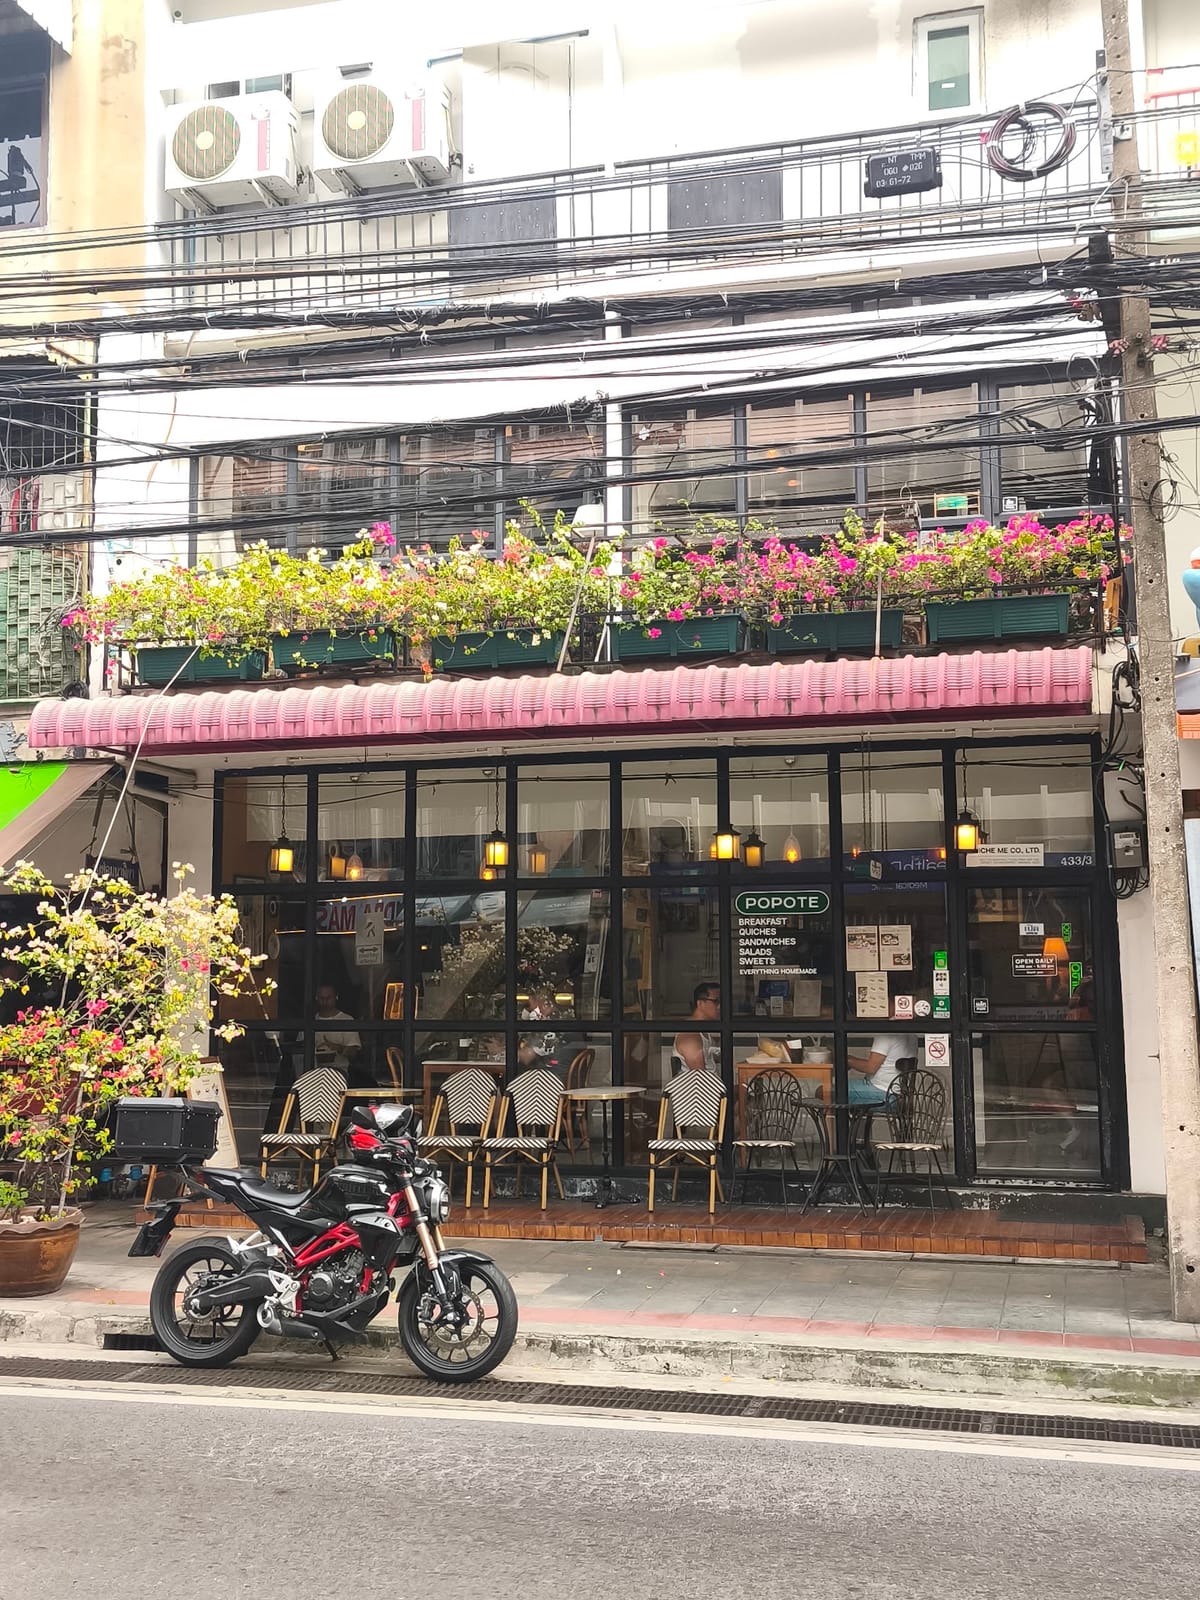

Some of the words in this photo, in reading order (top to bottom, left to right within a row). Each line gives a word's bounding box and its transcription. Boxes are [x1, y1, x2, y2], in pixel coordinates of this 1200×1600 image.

[1060, 855, 1093, 866] 433/3
[745, 896, 819, 910] POPOTE
[738, 917, 788, 926] BREAKFAST
[738, 928, 777, 936] QUICHES
[739, 937, 797, 946] SANDWICHES
[739, 948, 772, 956] SALADS
[739, 957, 776, 965] SWEETS
[780, 967, 817, 975] HOMEMADE
